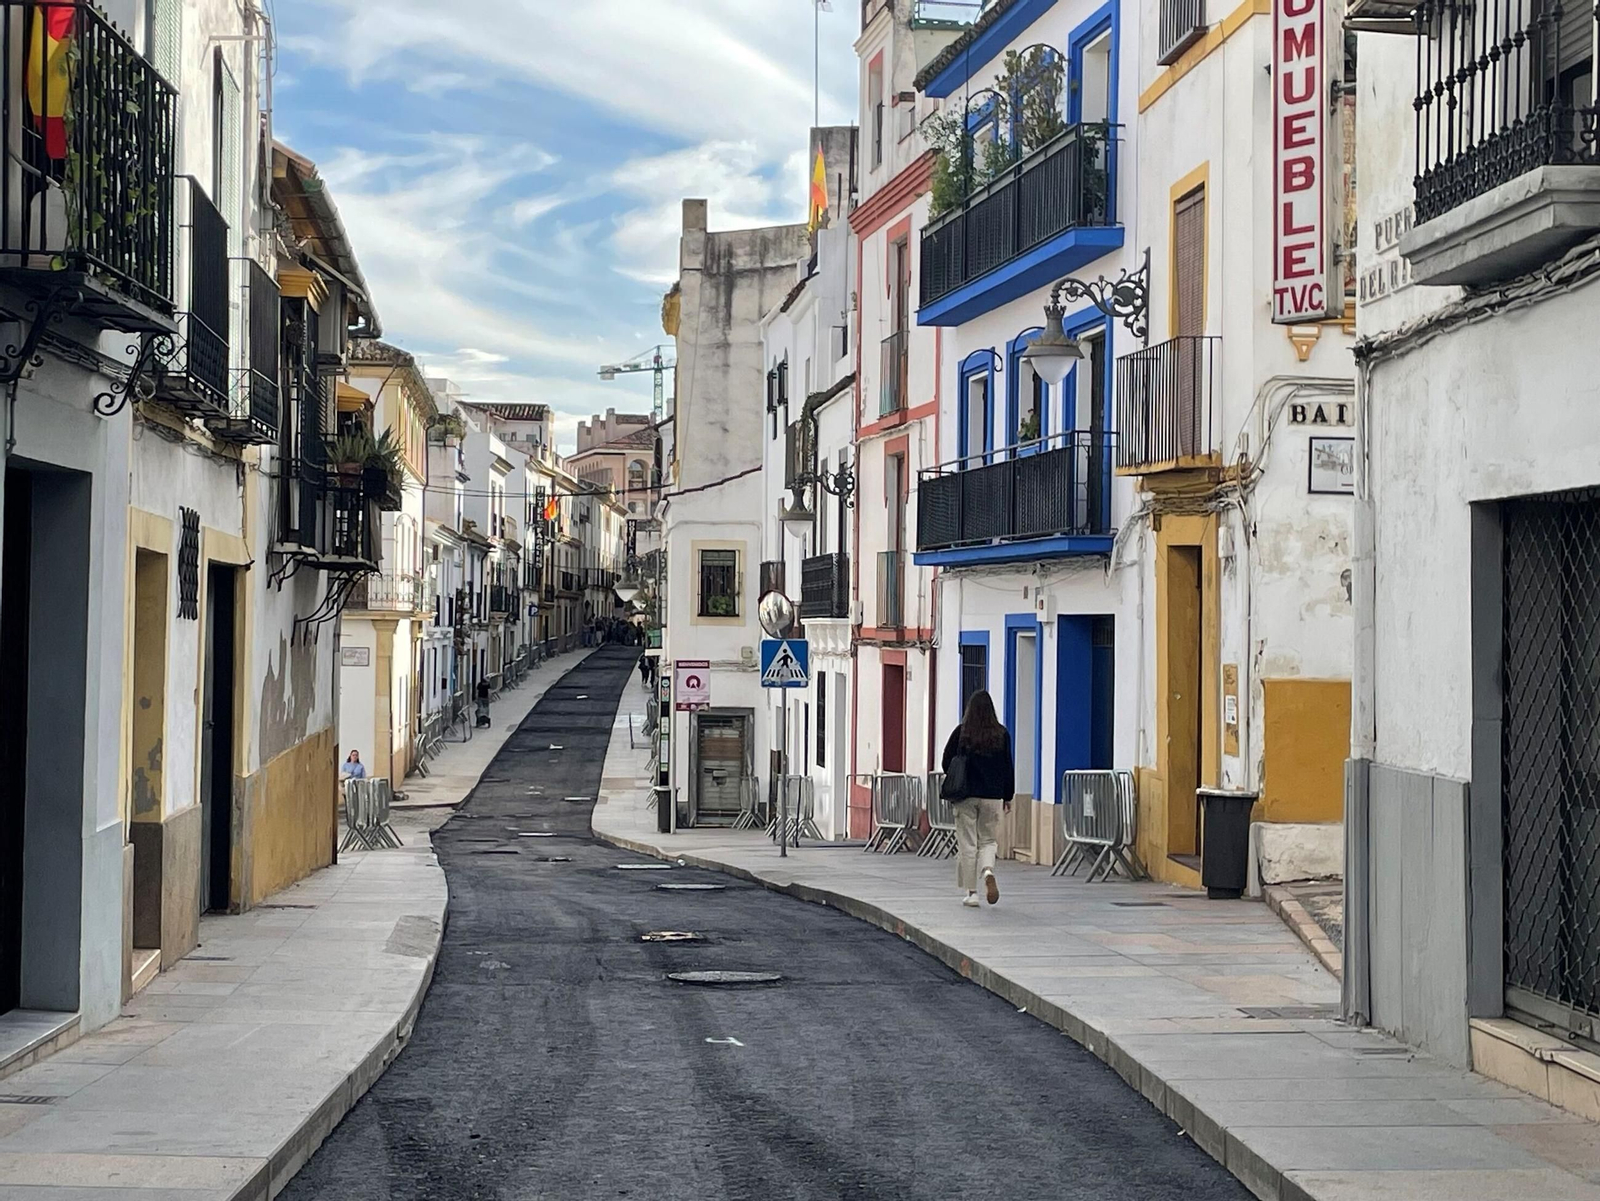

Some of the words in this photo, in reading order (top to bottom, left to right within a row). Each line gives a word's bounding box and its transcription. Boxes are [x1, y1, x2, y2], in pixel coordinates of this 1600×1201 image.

[1360, 267, 1386, 301] DEL
[1391, 257, 1415, 290] RI
[537, 486, 545, 521] HOTEL
